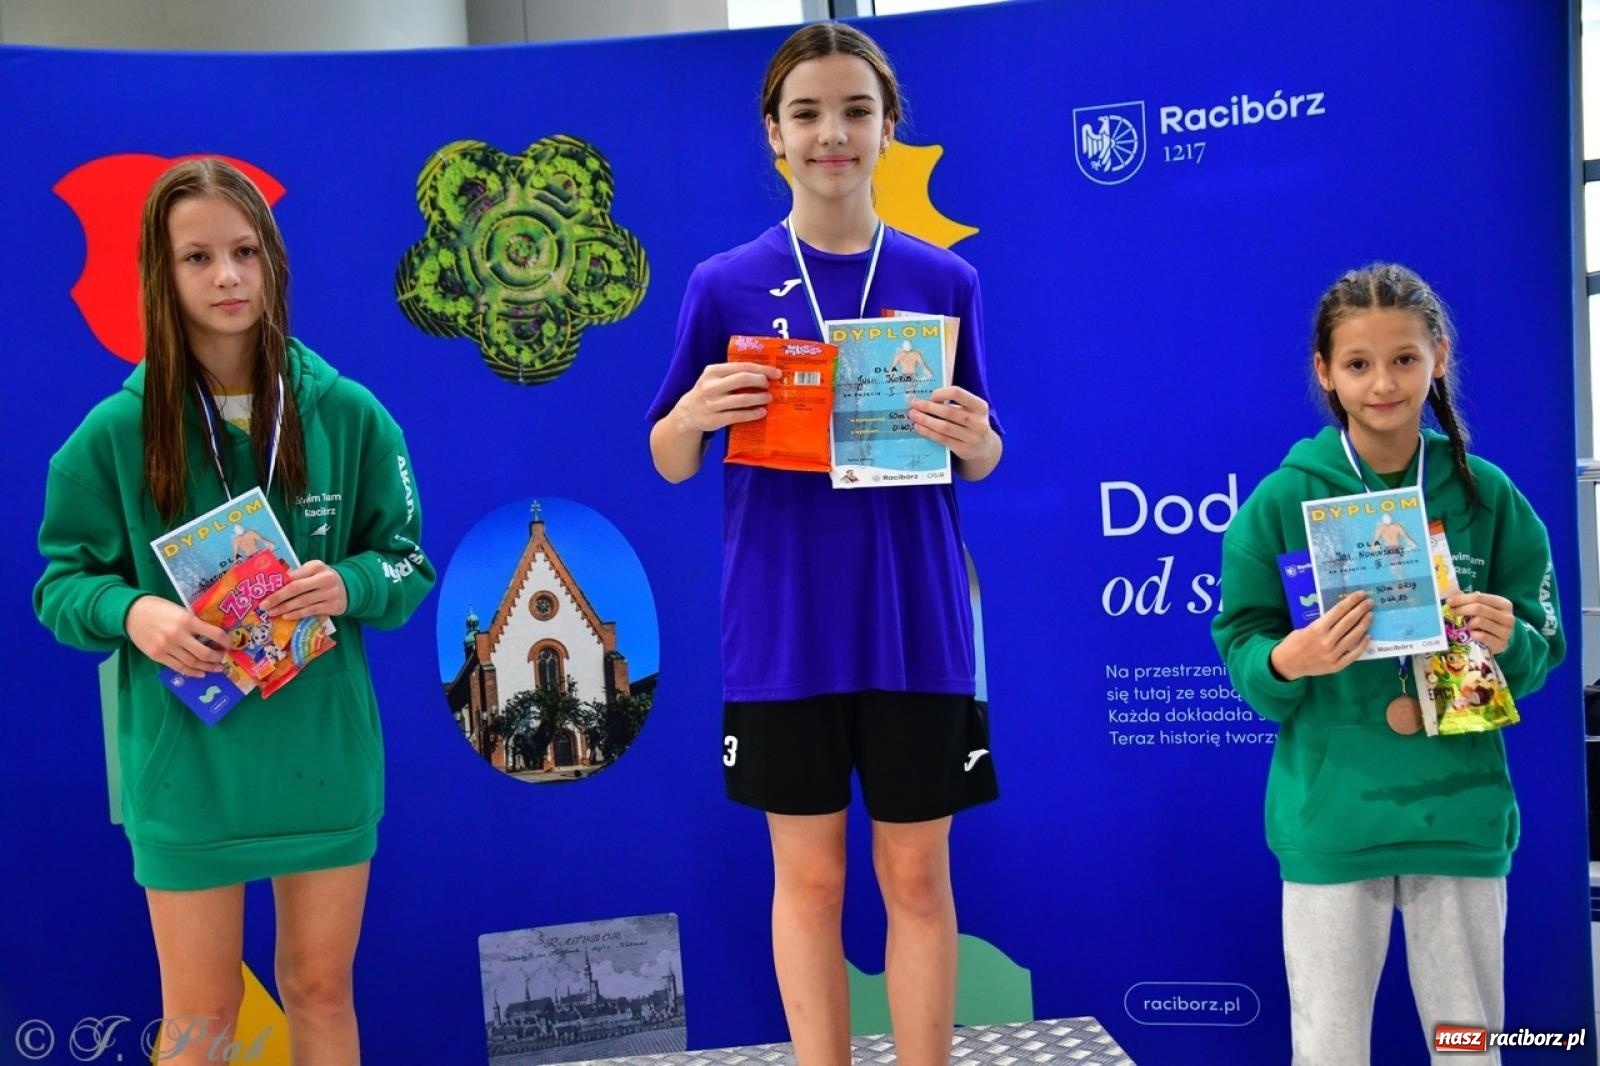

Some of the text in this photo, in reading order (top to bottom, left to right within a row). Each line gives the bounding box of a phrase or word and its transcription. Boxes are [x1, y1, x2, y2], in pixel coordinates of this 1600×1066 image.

[1159, 89, 1326, 135] Racibórz
[1163, 142, 1206, 164] 1217
[832, 326, 940, 342] DYPLOM
[1311, 496, 1419, 521] DYPLOM
[162, 499, 263, 558] DYPLOM
[1357, 540, 1381, 548] DLA
[219, 554, 243, 568] DLA
[1101, 555, 1175, 616] od
[1105, 662, 1227, 682] Na przestrzeni
[1107, 684, 1242, 704] się tutaj ze sobą
[1108, 707, 1160, 723] Każda
[1164, 706, 1252, 722] dokładała
[1109, 731, 1155, 745] Teraz
[1159, 730, 1220, 747] historię
[723, 735, 738, 767] 3
[1143, 996, 1241, 1016] raciborz.pl
